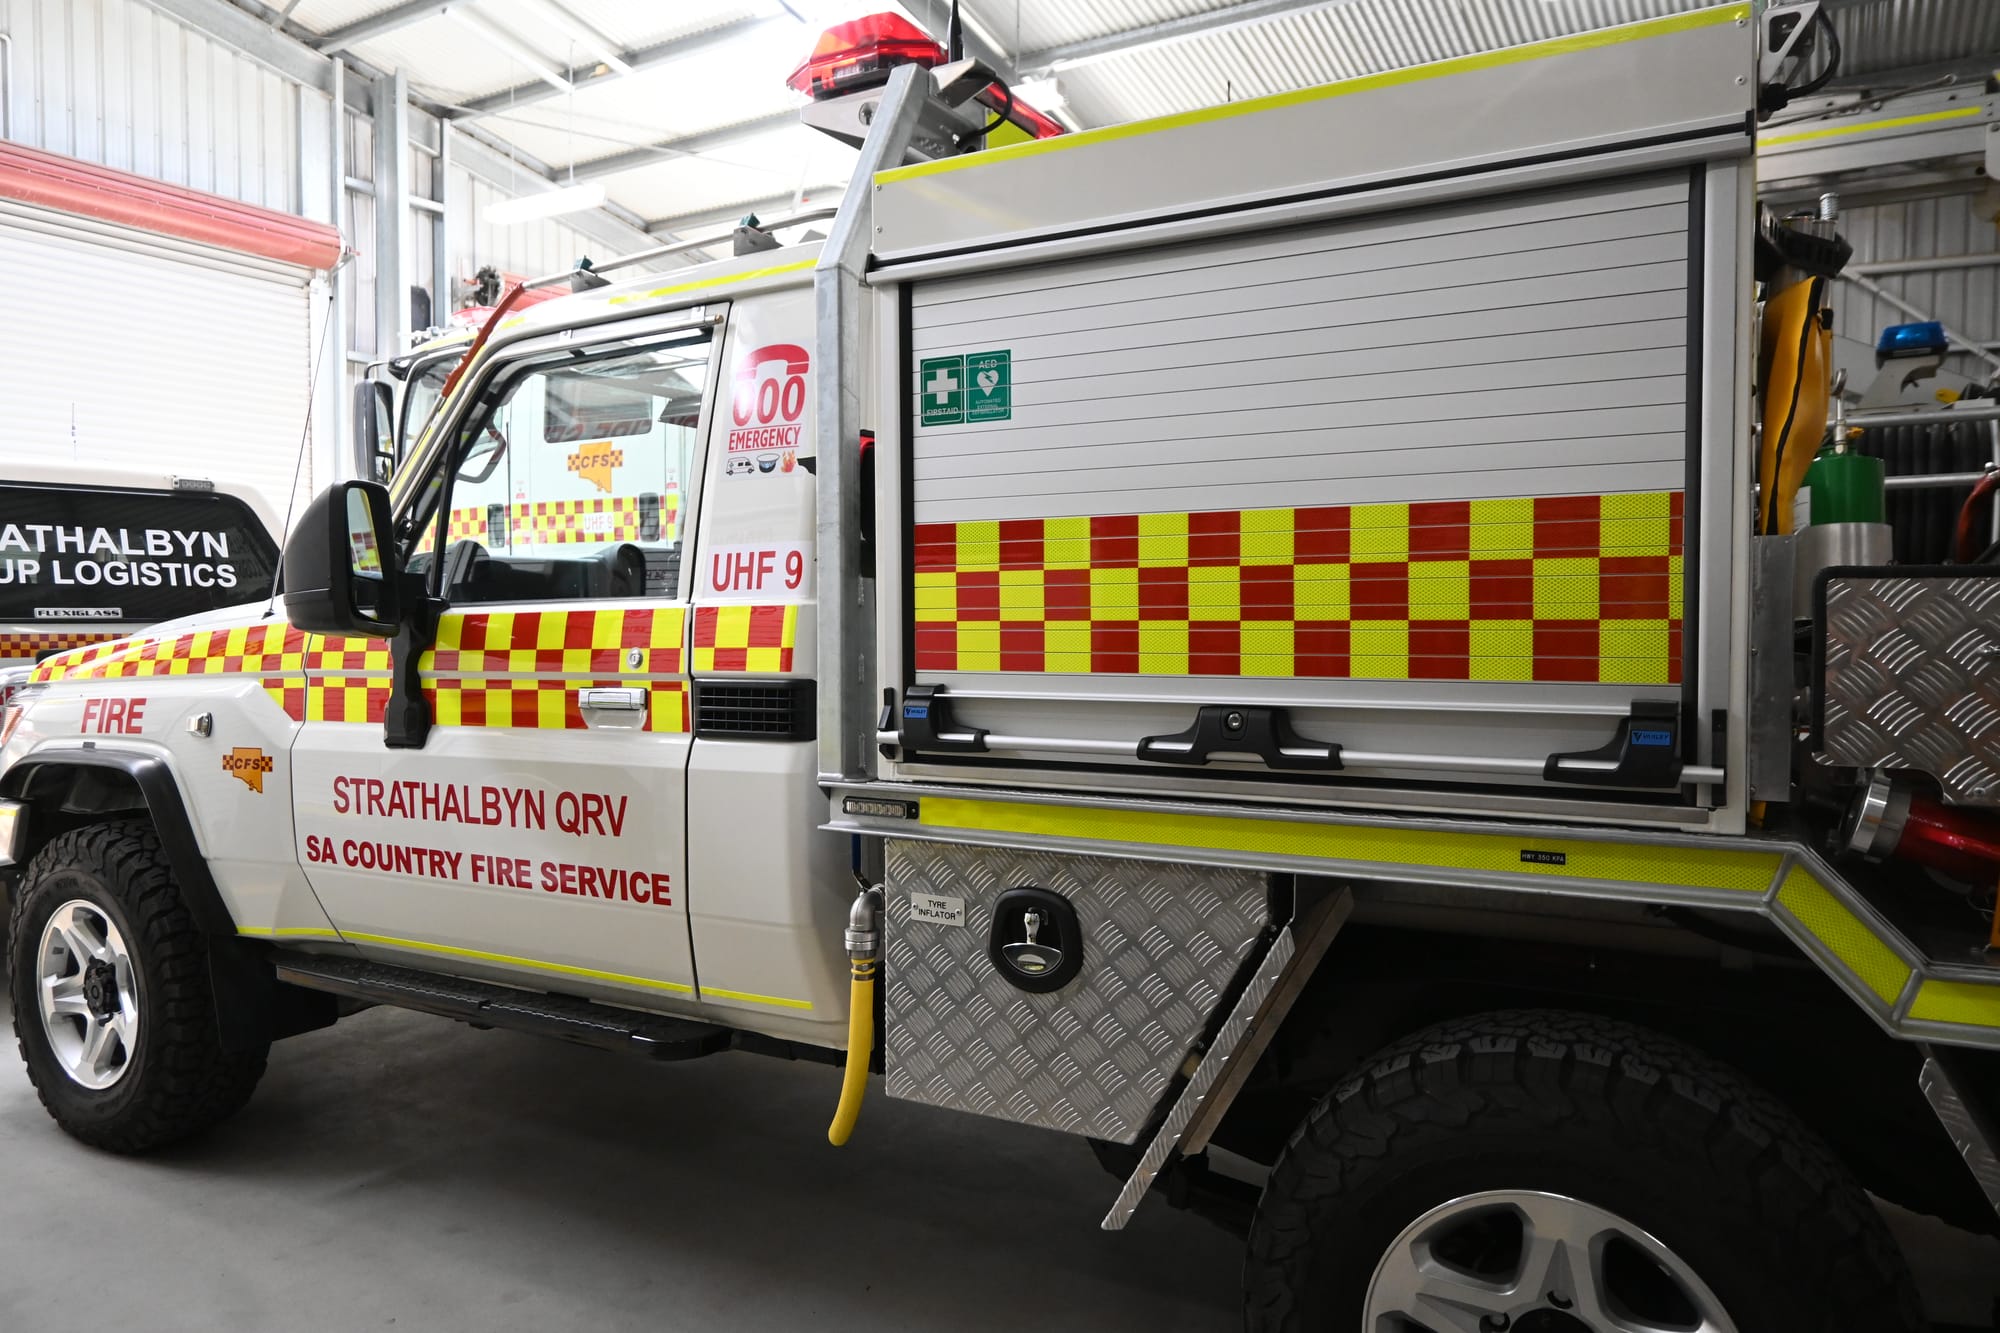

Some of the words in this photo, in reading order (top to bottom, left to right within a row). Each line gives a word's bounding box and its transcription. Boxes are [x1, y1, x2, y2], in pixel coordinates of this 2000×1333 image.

[979, 359, 998, 369] AED
[732, 375, 806, 427] 000
[728, 426, 801, 451] EMERGENCY
[581, 454, 610, 469] CFS
[0, 524, 229, 559] ATHALBYN
[52, 560, 238, 588] LOGISTICS
[712, 550, 776, 592] UHF
[784, 550, 803, 590] 9
[37, 609, 120, 617] FLEXIGLASS
[80, 698, 147, 734] FIRE
[234, 758, 261, 770] CFS
[333, 775, 546, 831] STRATHALBYN
[555, 790, 628, 837] QRV
[306, 834, 338, 865] SA
[342, 839, 463, 880] COUNTRY
[471, 853, 533, 890] FIRE
[540, 861, 672, 907] SERVICE
[918, 908, 956, 921] INFLATOR
[928, 899, 948, 910] TYRE
